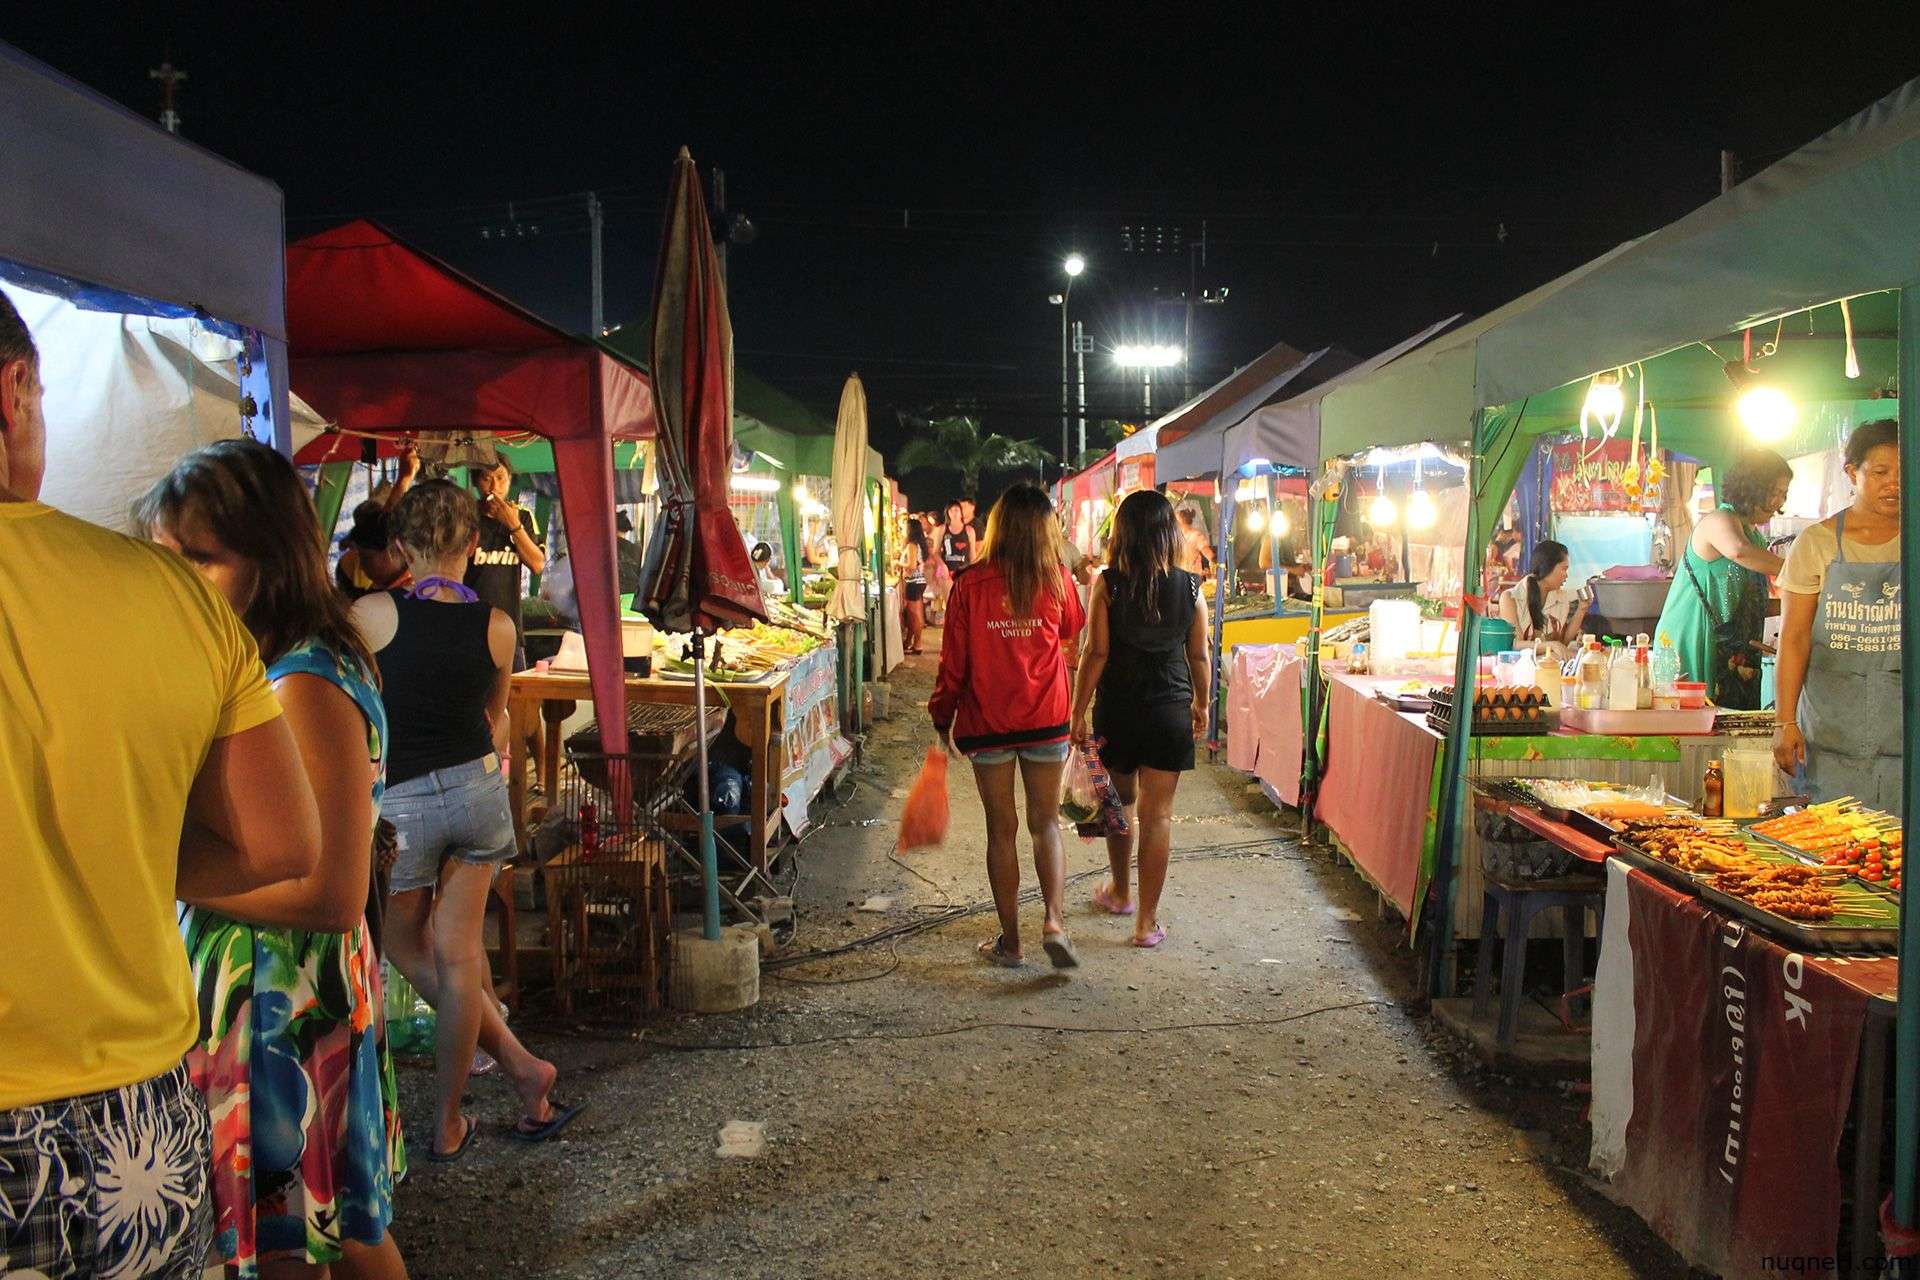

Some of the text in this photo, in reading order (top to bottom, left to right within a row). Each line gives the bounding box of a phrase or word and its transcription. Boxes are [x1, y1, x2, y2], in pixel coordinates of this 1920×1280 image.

[474, 546, 519, 566] bwin
[987, 619, 1043, 630] MANCHSTER
[1001, 629, 1032, 638] UNITED
